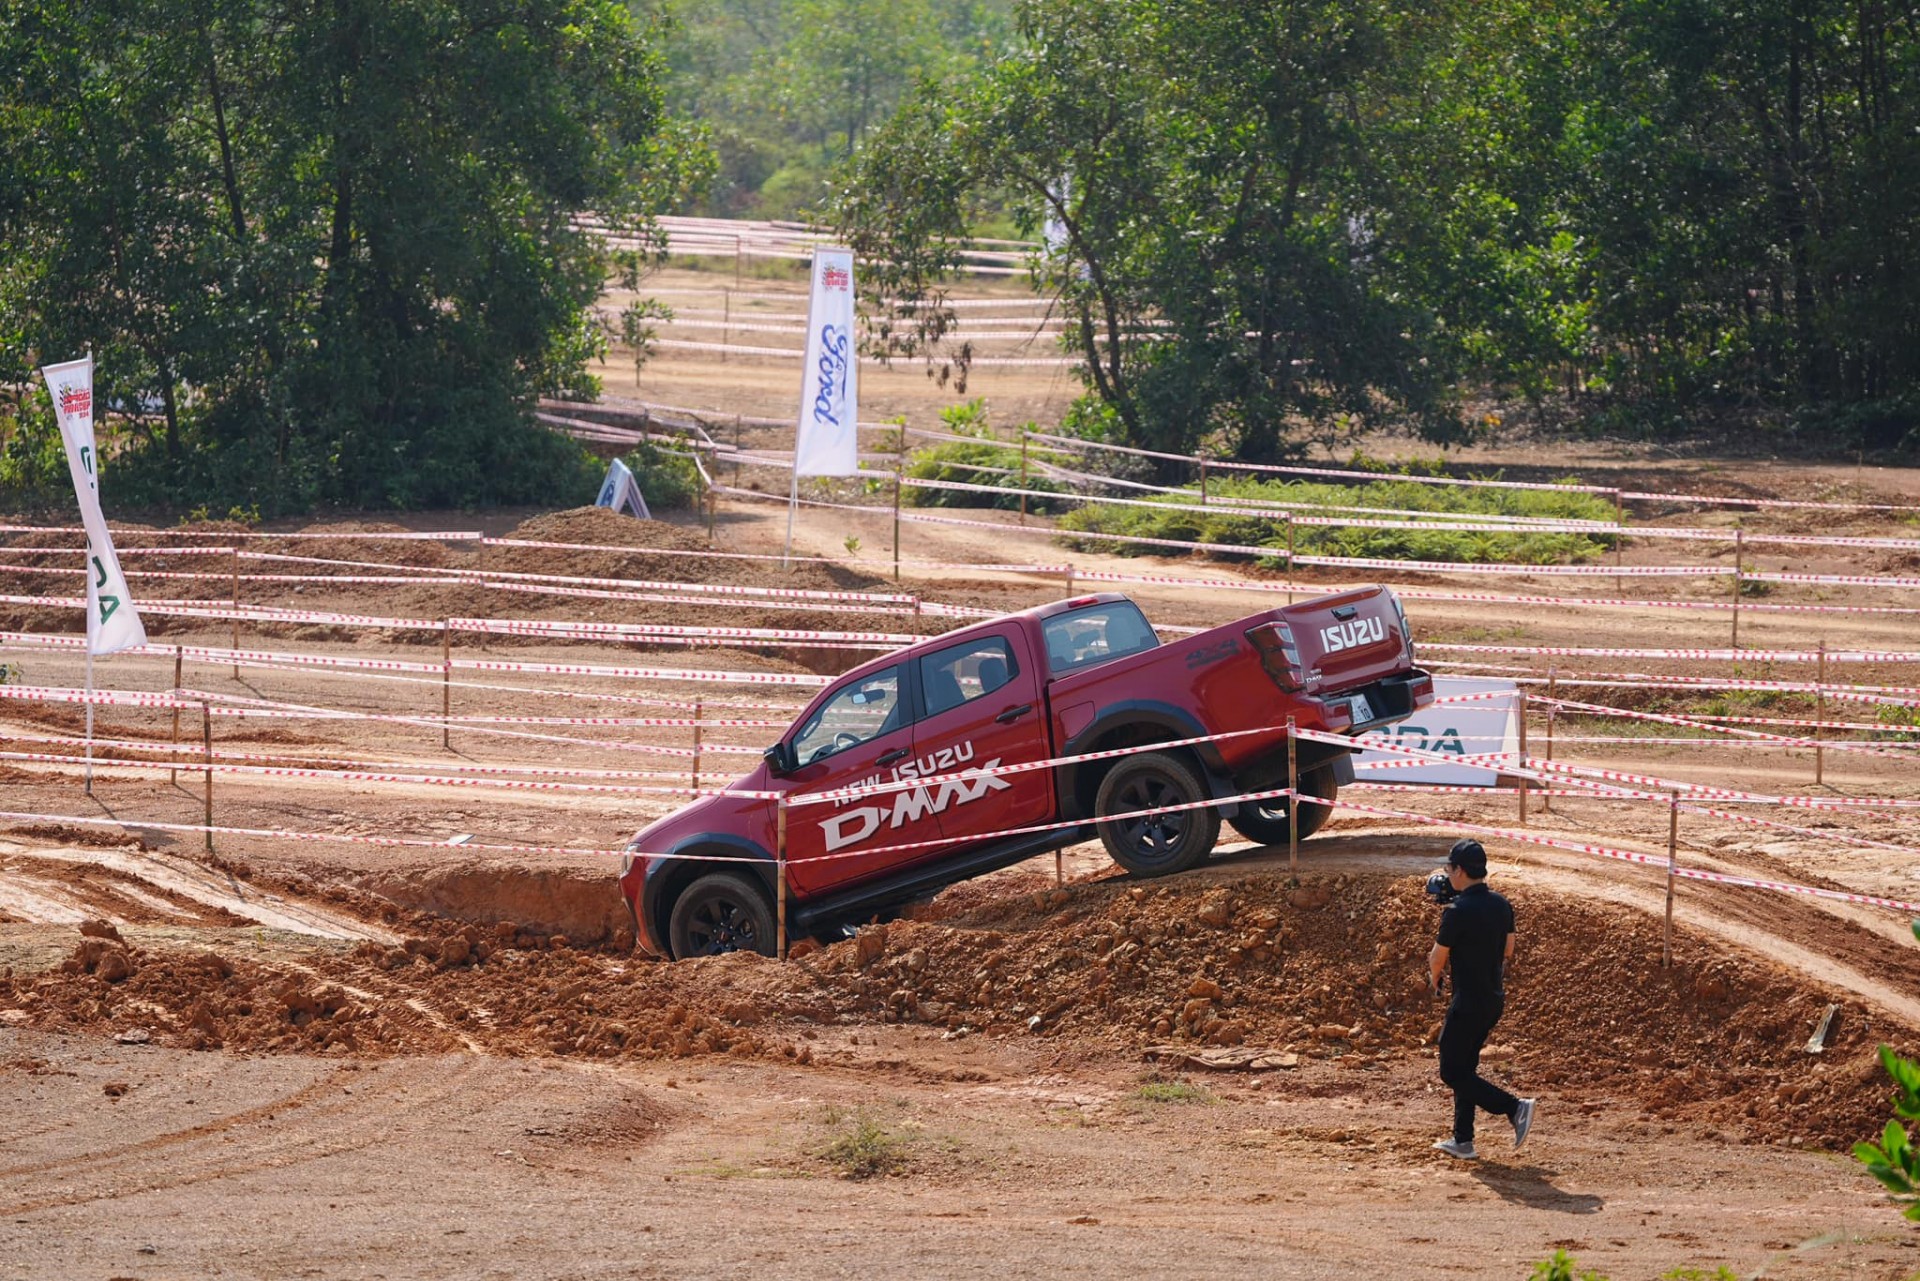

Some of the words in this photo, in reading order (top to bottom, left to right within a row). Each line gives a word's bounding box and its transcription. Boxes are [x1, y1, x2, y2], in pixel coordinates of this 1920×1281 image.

[814, 324, 848, 426] Ford
[1319, 616, 1384, 654] ISUZU
[891, 740, 975, 783] ISUZU
